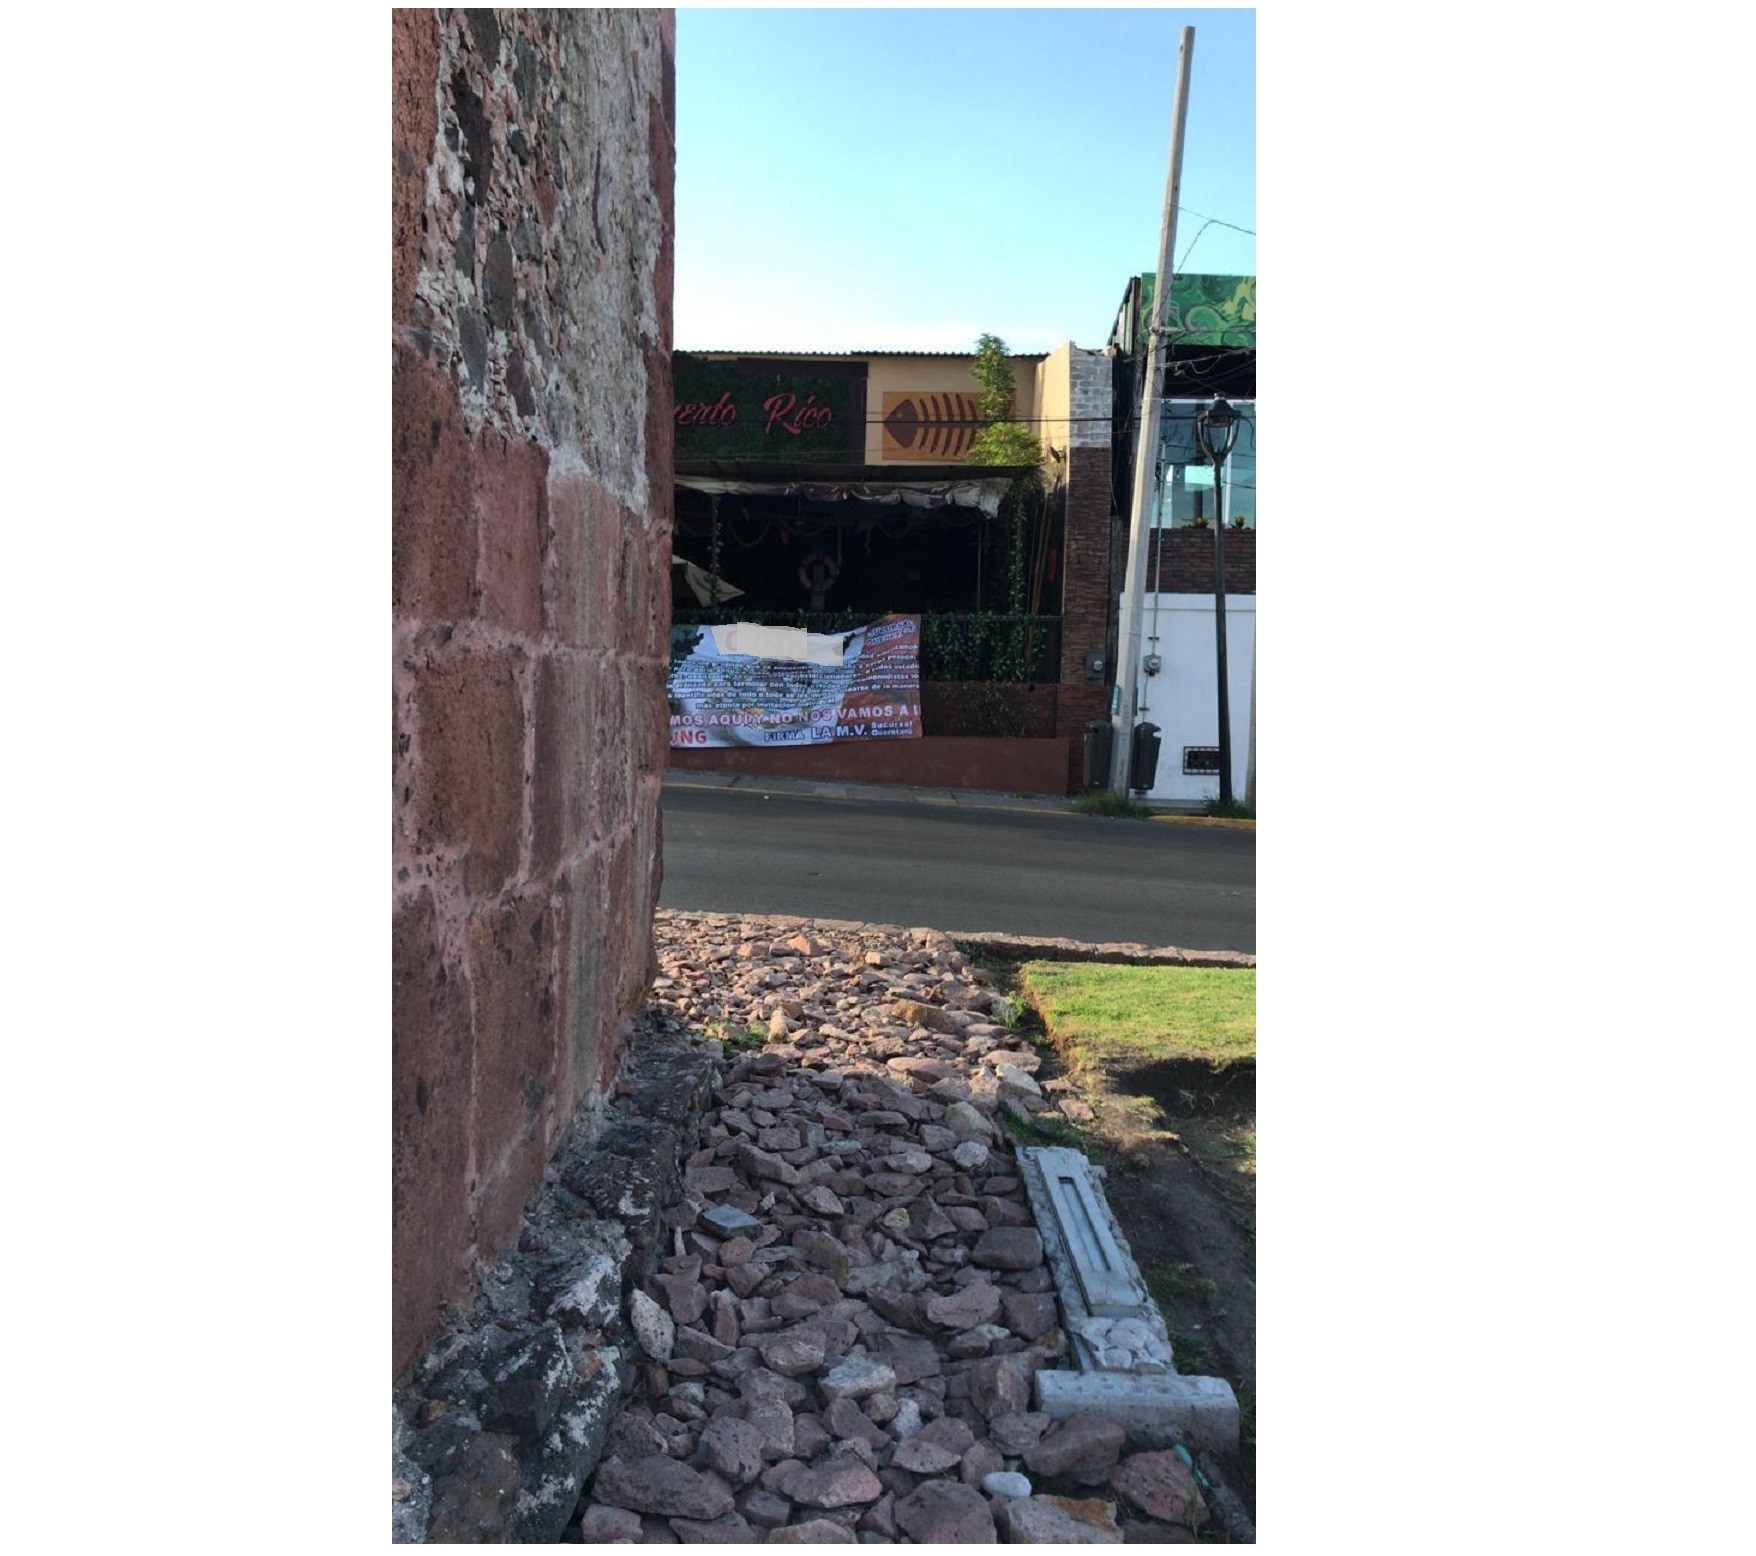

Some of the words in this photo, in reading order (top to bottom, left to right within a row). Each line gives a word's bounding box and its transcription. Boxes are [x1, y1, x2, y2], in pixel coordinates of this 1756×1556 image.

[763, 392, 832, 435] Rico
[669, 715, 703, 726] MOS
[770, 713, 793, 724] NO
[799, 709, 832, 722] NOS
[838, 705, 893, 719] VAMOS
[900, 704, 909, 716] A
[670, 729, 708, 745] JNG
[764, 729, 805, 742] FIRMA
